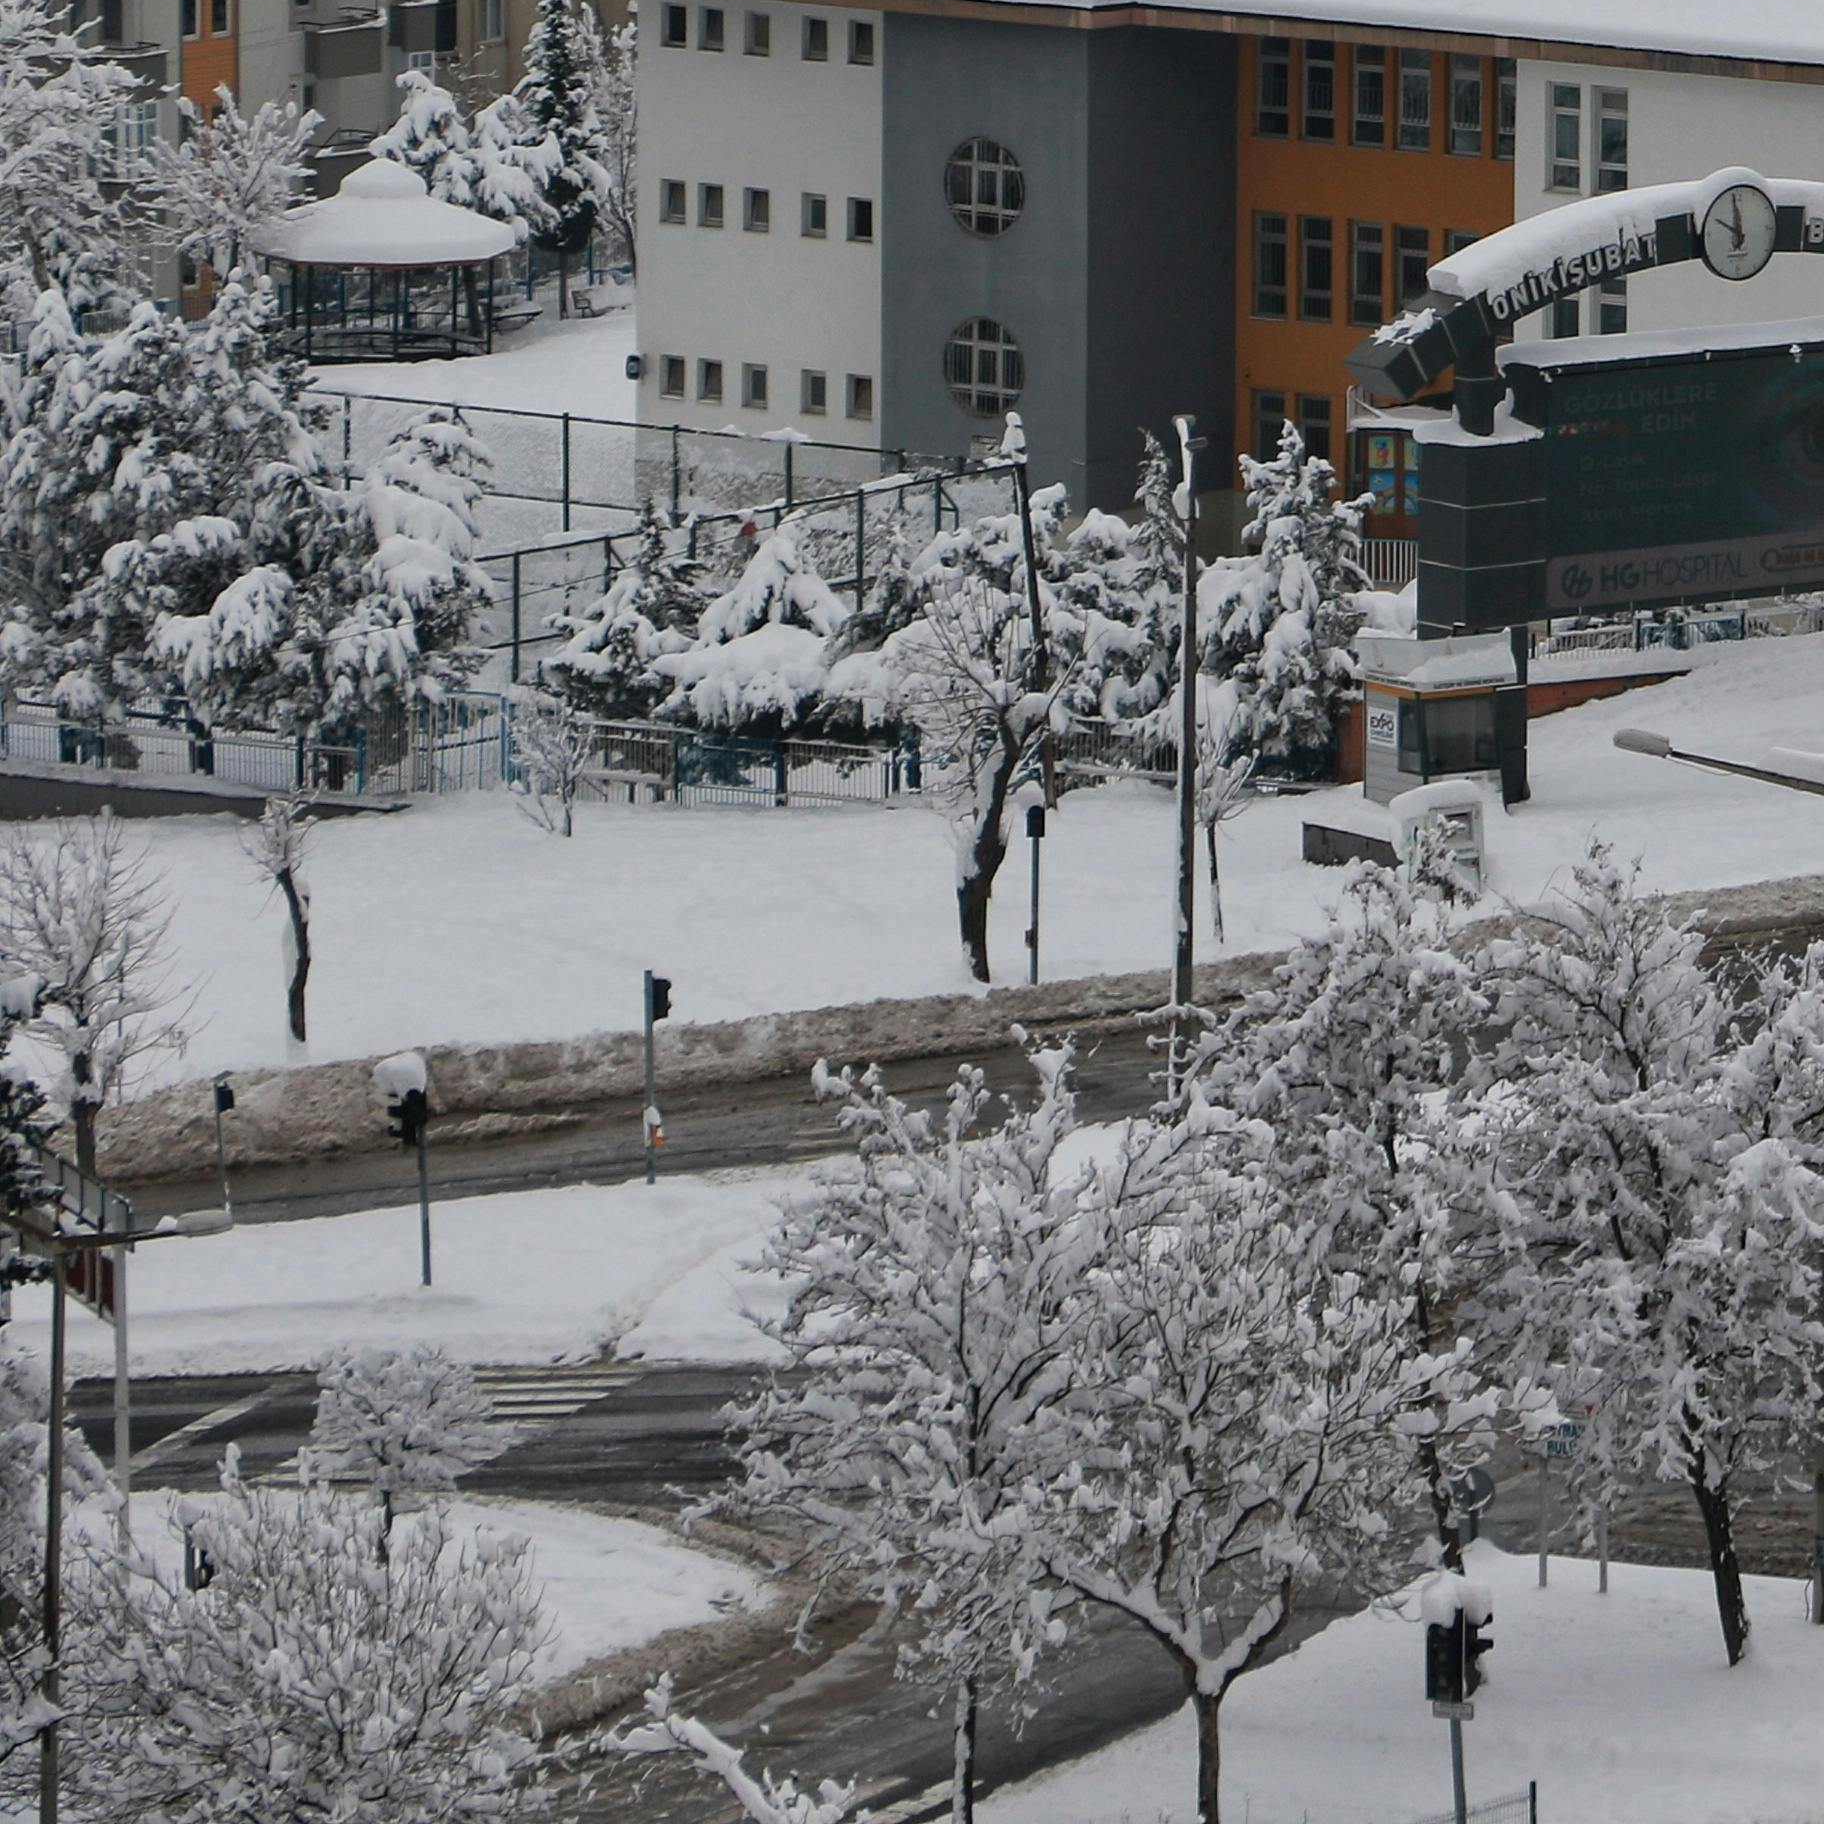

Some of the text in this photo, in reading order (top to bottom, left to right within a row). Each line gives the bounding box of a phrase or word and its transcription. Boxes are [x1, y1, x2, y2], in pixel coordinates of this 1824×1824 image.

[1491, 232, 1658, 322] ONİKİŞUBAT
[1565, 382, 1718, 415] GÖZLÜKLERE
[1641, 410, 1697, 434] EDİN
